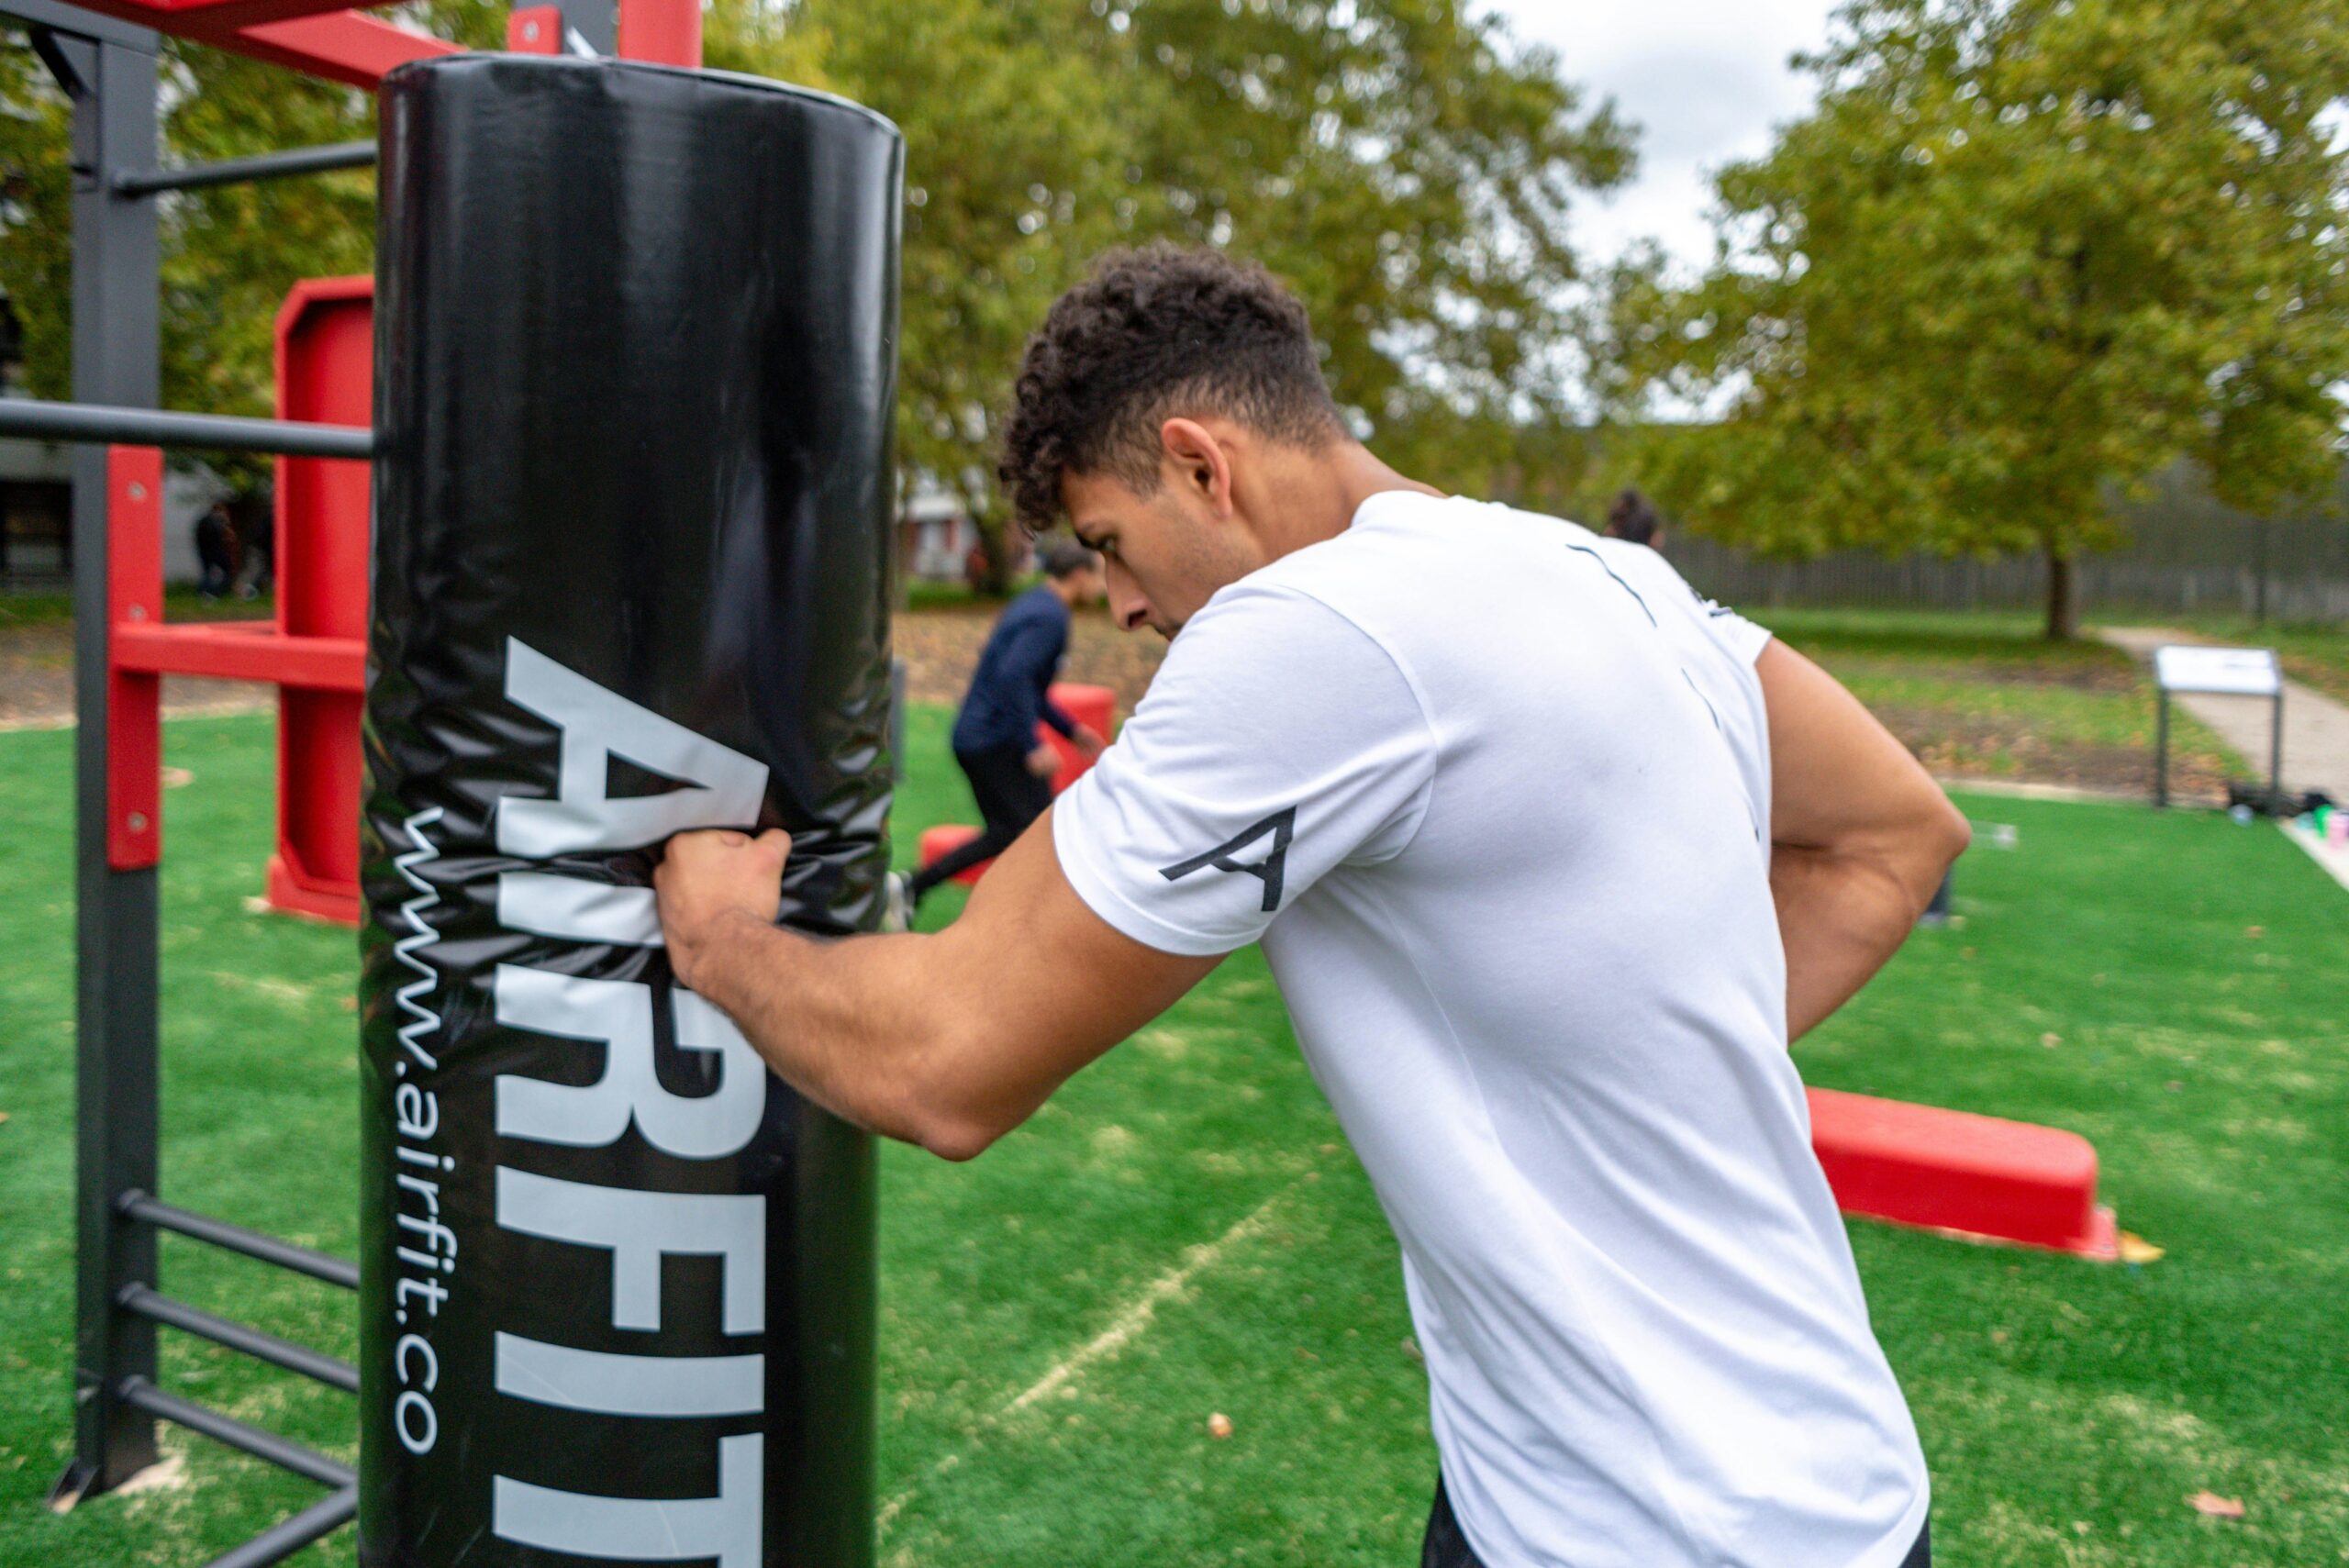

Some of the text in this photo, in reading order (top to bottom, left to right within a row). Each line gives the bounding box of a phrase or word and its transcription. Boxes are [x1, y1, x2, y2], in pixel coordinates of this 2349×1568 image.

[395, 806, 457, 1455] www.airfit.co
[494, 635, 770, 1568] AIRFIT
[1158, 804, 1297, 912] A
